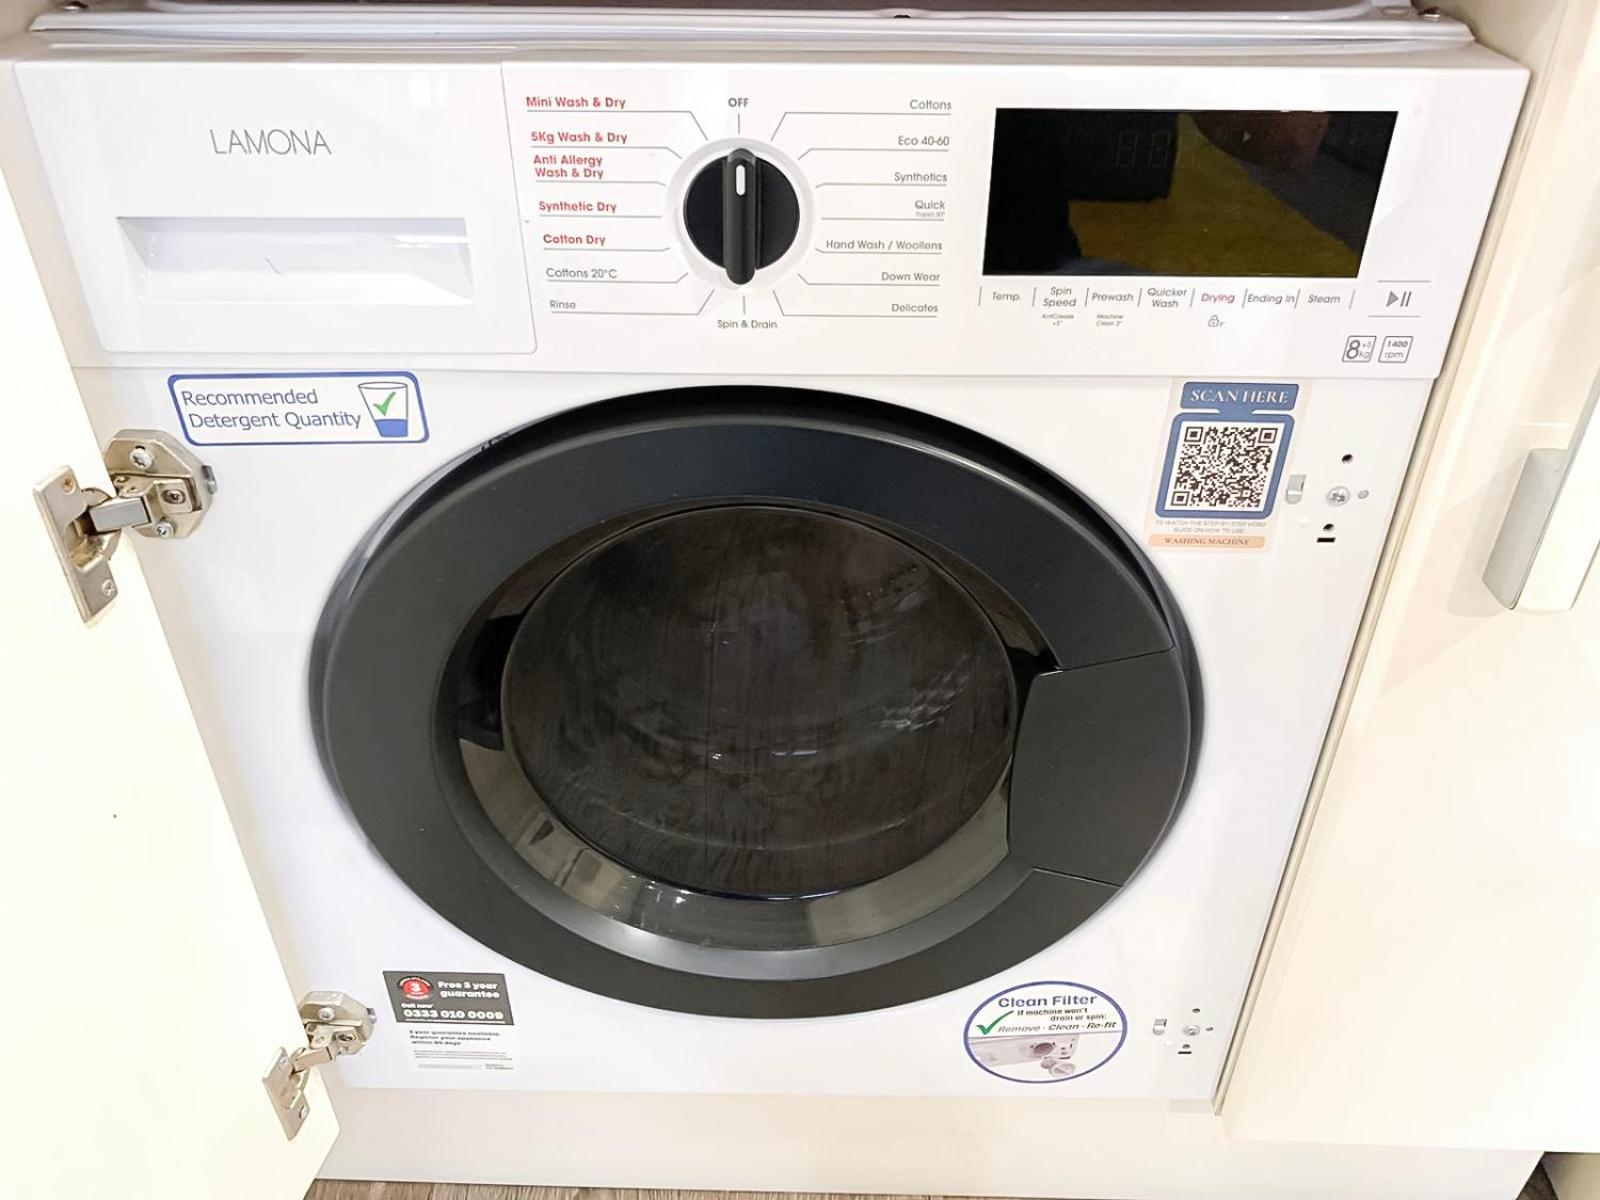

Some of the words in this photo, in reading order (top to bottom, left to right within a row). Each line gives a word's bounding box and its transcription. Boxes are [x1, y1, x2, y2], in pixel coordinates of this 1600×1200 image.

[526, 96, 552, 108] Mini
[554, 97, 591, 108] Wash
[593, 98, 602, 108] &
[605, 97, 626, 110] Dry
[728, 97, 749, 108] OFF
[909, 99, 952, 110] Cottons
[209, 128, 333, 156] LAMONA
[531, 131, 555, 144] 5Kg
[556, 132, 591, 143] Wash
[594, 132, 603, 143] &
[607, 132, 628, 145] Dry
[898, 135, 919, 146] Eco
[921, 135, 950, 146] 40-60
[533, 154, 558, 166] Anti
[560, 154, 603, 167] Allergy
[534, 167, 568, 178] Wash
[571, 168, 580, 178] &
[583, 167, 604, 180] Dry
[894, 171, 948, 184] Synthetics
[539, 200, 593, 214] Synthetic
[596, 201, 617, 214] Dry
[914, 199, 946, 210] Quick
[543, 234, 583, 245] Cotton
[585, 234, 606, 247] Dry
[826, 239, 854, 250] Hand
[857, 240, 884, 250] Wash
[887, 240, 894, 251] /
[896, 240, 943, 251] Woollens
[546, 268, 588, 279] Cottons
[591, 268, 618, 279] 20°C
[881, 271, 911, 282] Down
[913, 272, 940, 282] Wear
[992, 291, 1022, 303] Temp.
[1050, 286, 1072, 297] Spin
[1091, 292, 1134, 302] Prewash
[1147, 287, 1188, 297] Quicker
[1043, 298, 1077, 309] Speed
[1151, 298, 1179, 308] Wash
[1200, 292, 1236, 304] Drying
[1247, 293, 1283, 304] Ending
[1285, 293, 1295, 303] In
[1308, 294, 1341, 304] Steam
[549, 299, 576, 310] Rinse
[891, 302, 939, 313] Delicates
[717, 319, 739, 330] Spin
[740, 320, 749, 330] &
[751, 319, 778, 330] Drain
[1345, 339, 1361, 360] 8
[1386, 340, 1409, 348] 1400
[1384, 350, 1404, 361] rpm
[181, 388, 319, 407] Recommended
[1190, 389, 1239, 403] SCAN
[1242, 390, 1290, 404] HERE
[188, 412, 281, 430] Detergent
[284, 411, 361, 429] Quantity
[1164, 537, 1206, 545] WASHING
[1208, 538, 1250, 546] MACHINE
[410, 982, 421, 992] 3
[438, 981, 462, 989] Free
[464, 981, 471, 989] 3
[440, 990, 500, 998] guarantee
[998, 996, 1048, 1008] Clean
[1052, 994, 1098, 1006] Filter
[403, 1009, 439, 1018] 0333
[441, 1010, 465, 1019] 010
[1025, 1008, 1063, 1016] machine
[997, 1025, 1041, 1033] Remove
[1048, 1023, 1080, 1032] Clean
[1086, 1021, 1117, 1030] Re-fit
